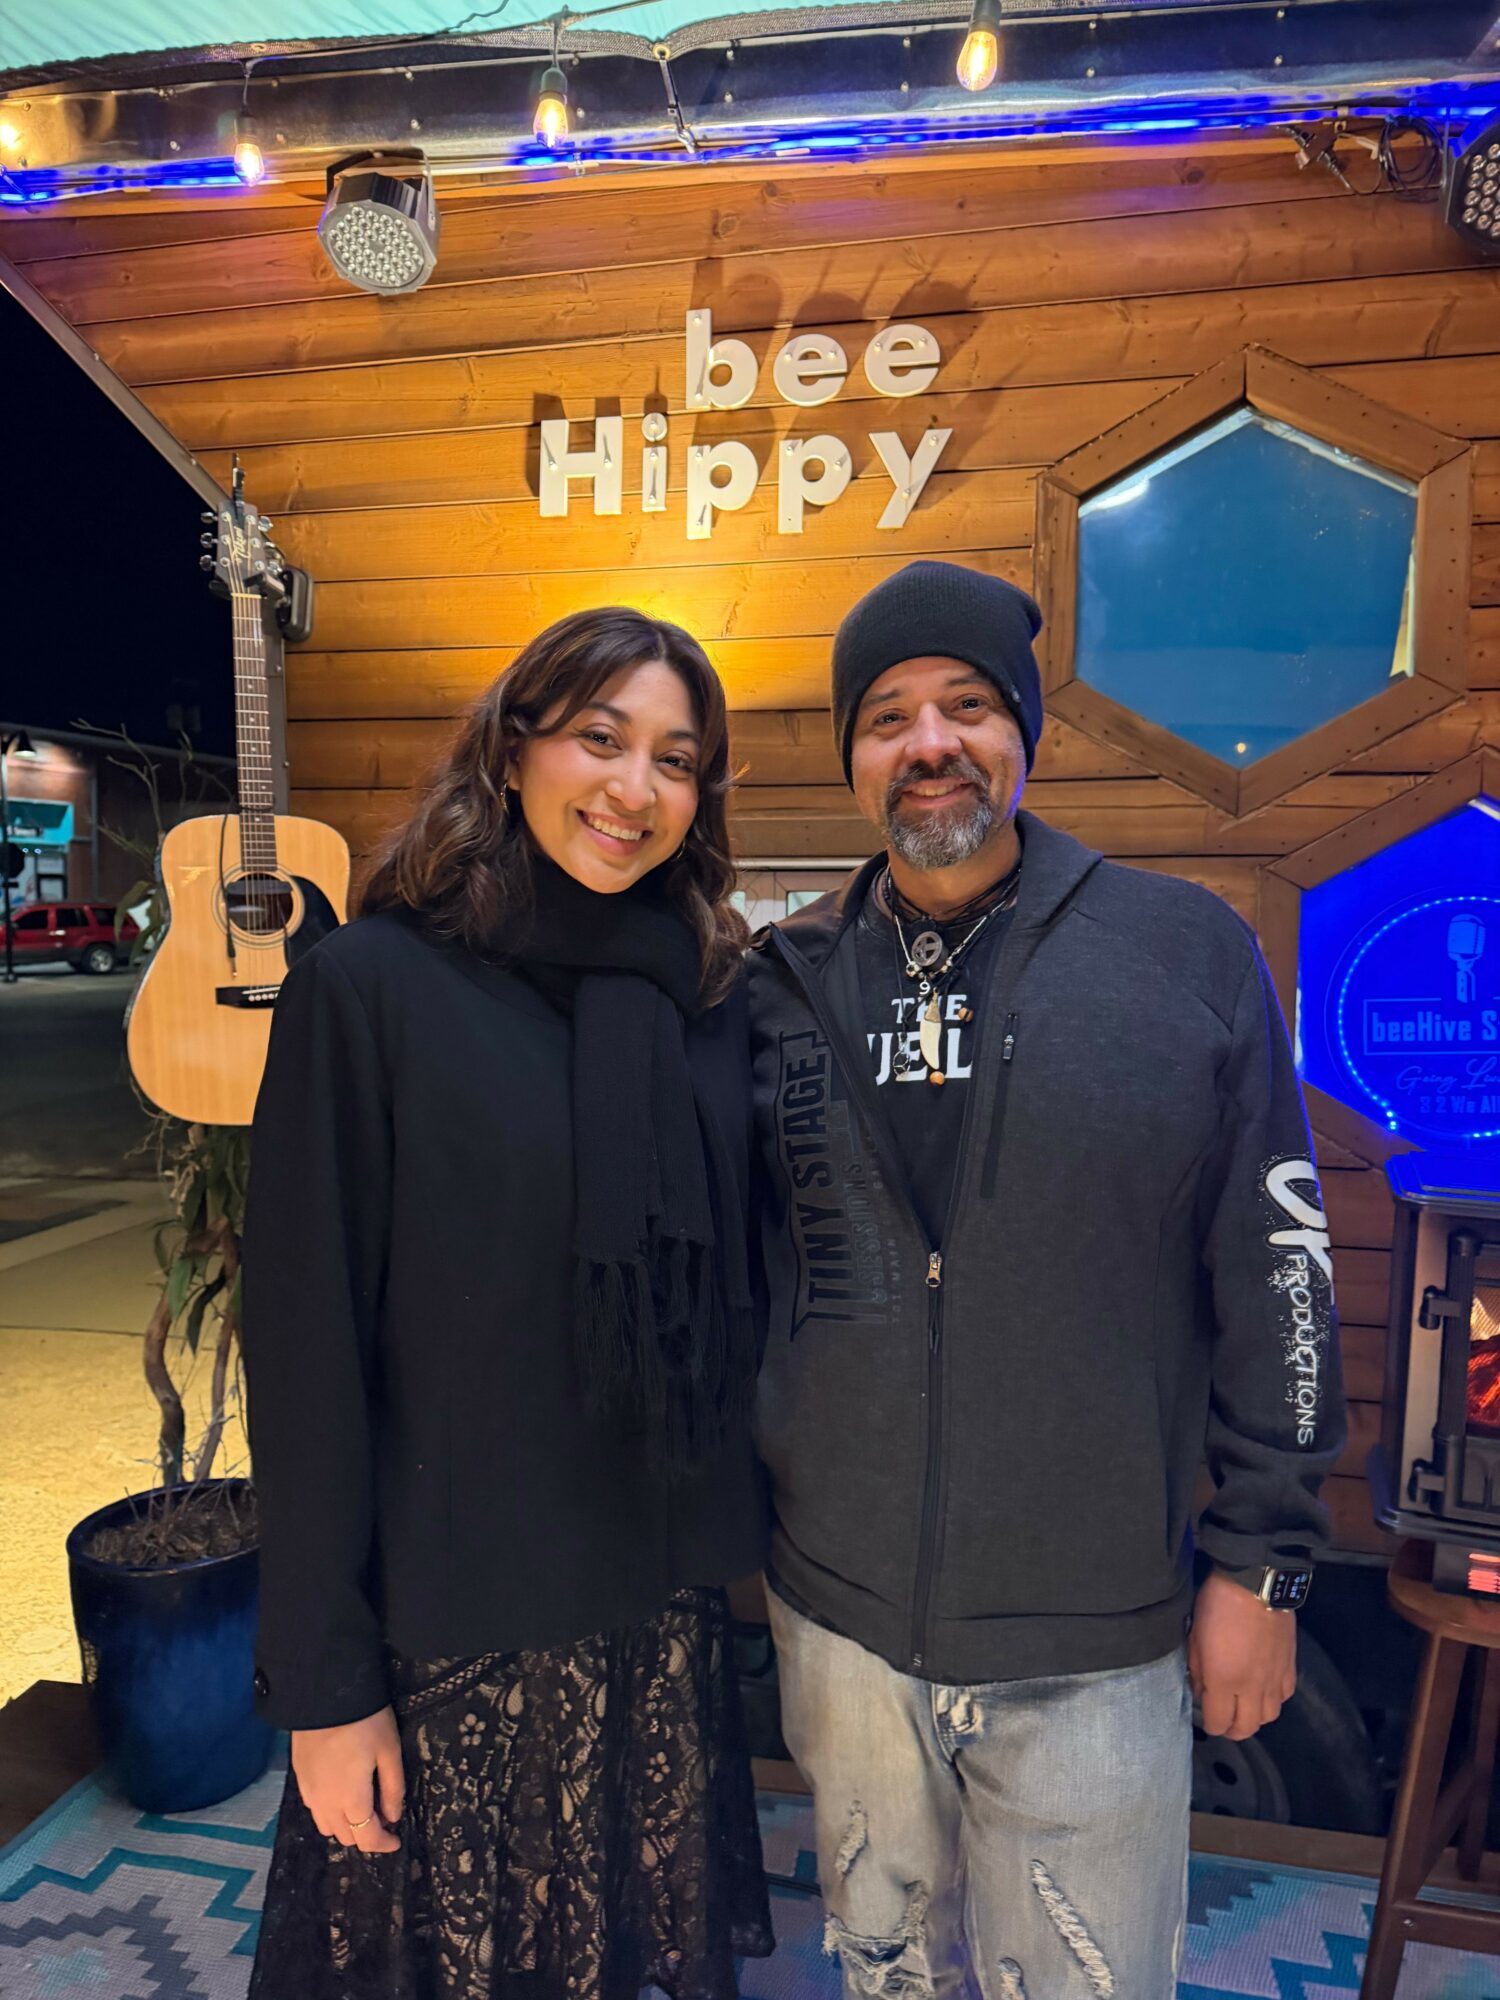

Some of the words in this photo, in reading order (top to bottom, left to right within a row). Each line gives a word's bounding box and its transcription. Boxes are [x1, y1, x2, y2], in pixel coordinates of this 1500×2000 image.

[686, 308, 941, 410] bee
[540, 412, 953, 540] Hippy
[1372, 1011, 1472, 1042] beeHive
[783, 1053, 833, 1190] STAGE
[797, 1203, 866, 1304] TINY
[1286, 1252, 1317, 1446] PRODUCTIONS
